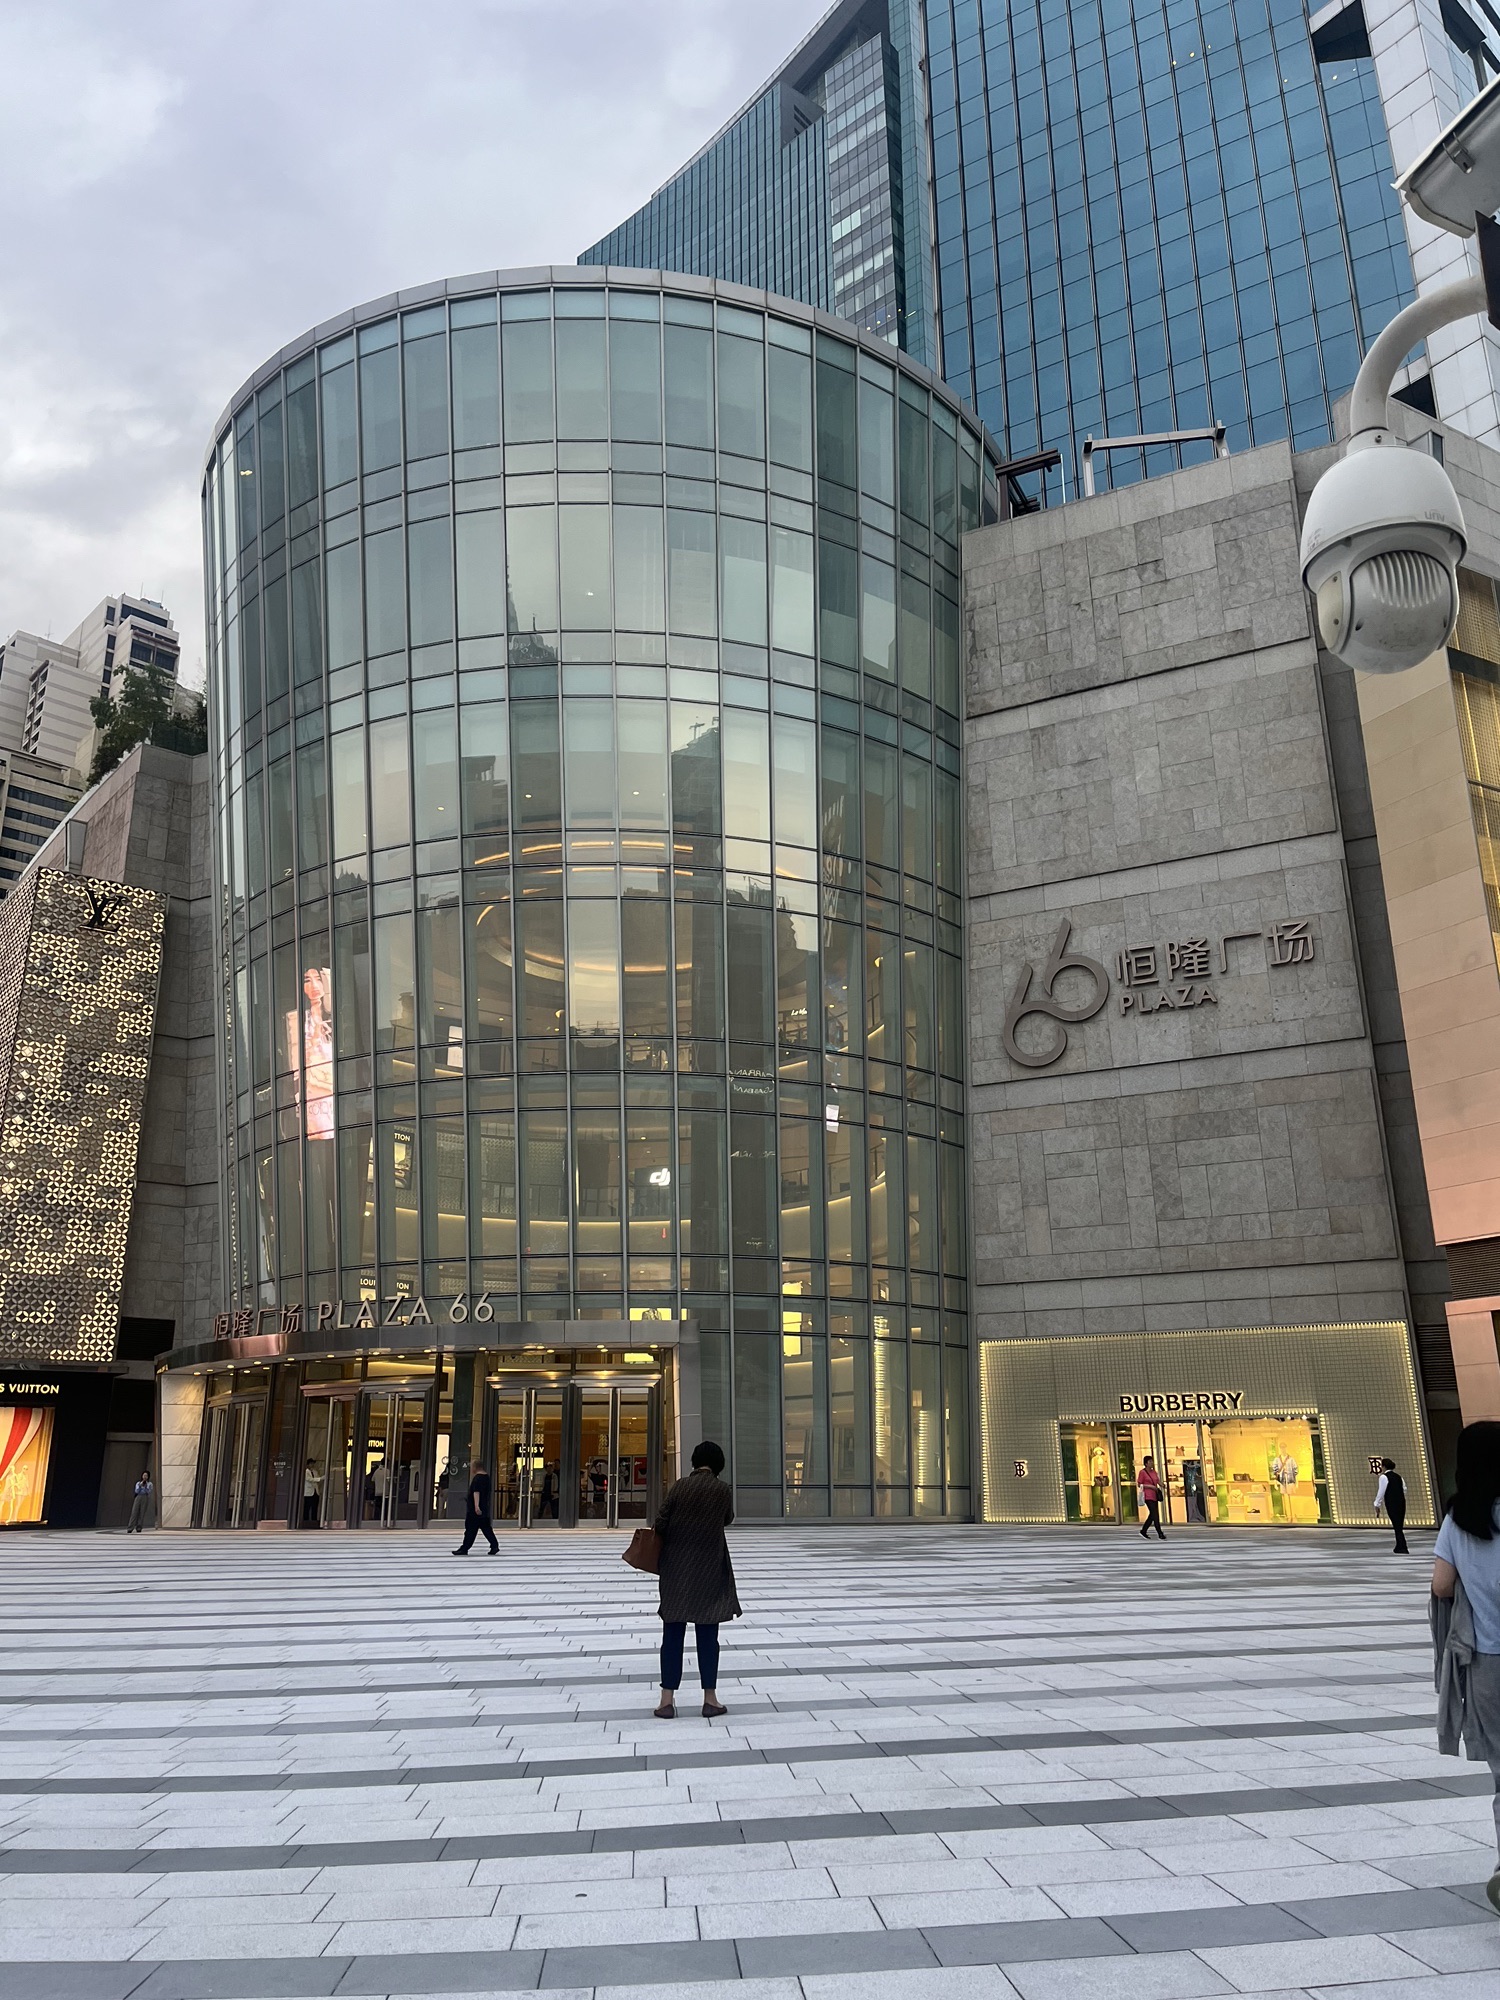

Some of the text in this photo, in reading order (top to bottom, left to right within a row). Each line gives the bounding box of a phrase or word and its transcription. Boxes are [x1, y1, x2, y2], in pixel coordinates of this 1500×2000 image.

[1115, 920, 1315, 987] 恒隆广场
[1119, 985, 1218, 1016] PLAZA
[214, 1291, 494, 1341] 恒隆广场 PLAZA 66
[8, 1383, 60, 1395] VUITTON
[1118, 1391, 1244, 1413] BURBERRY
